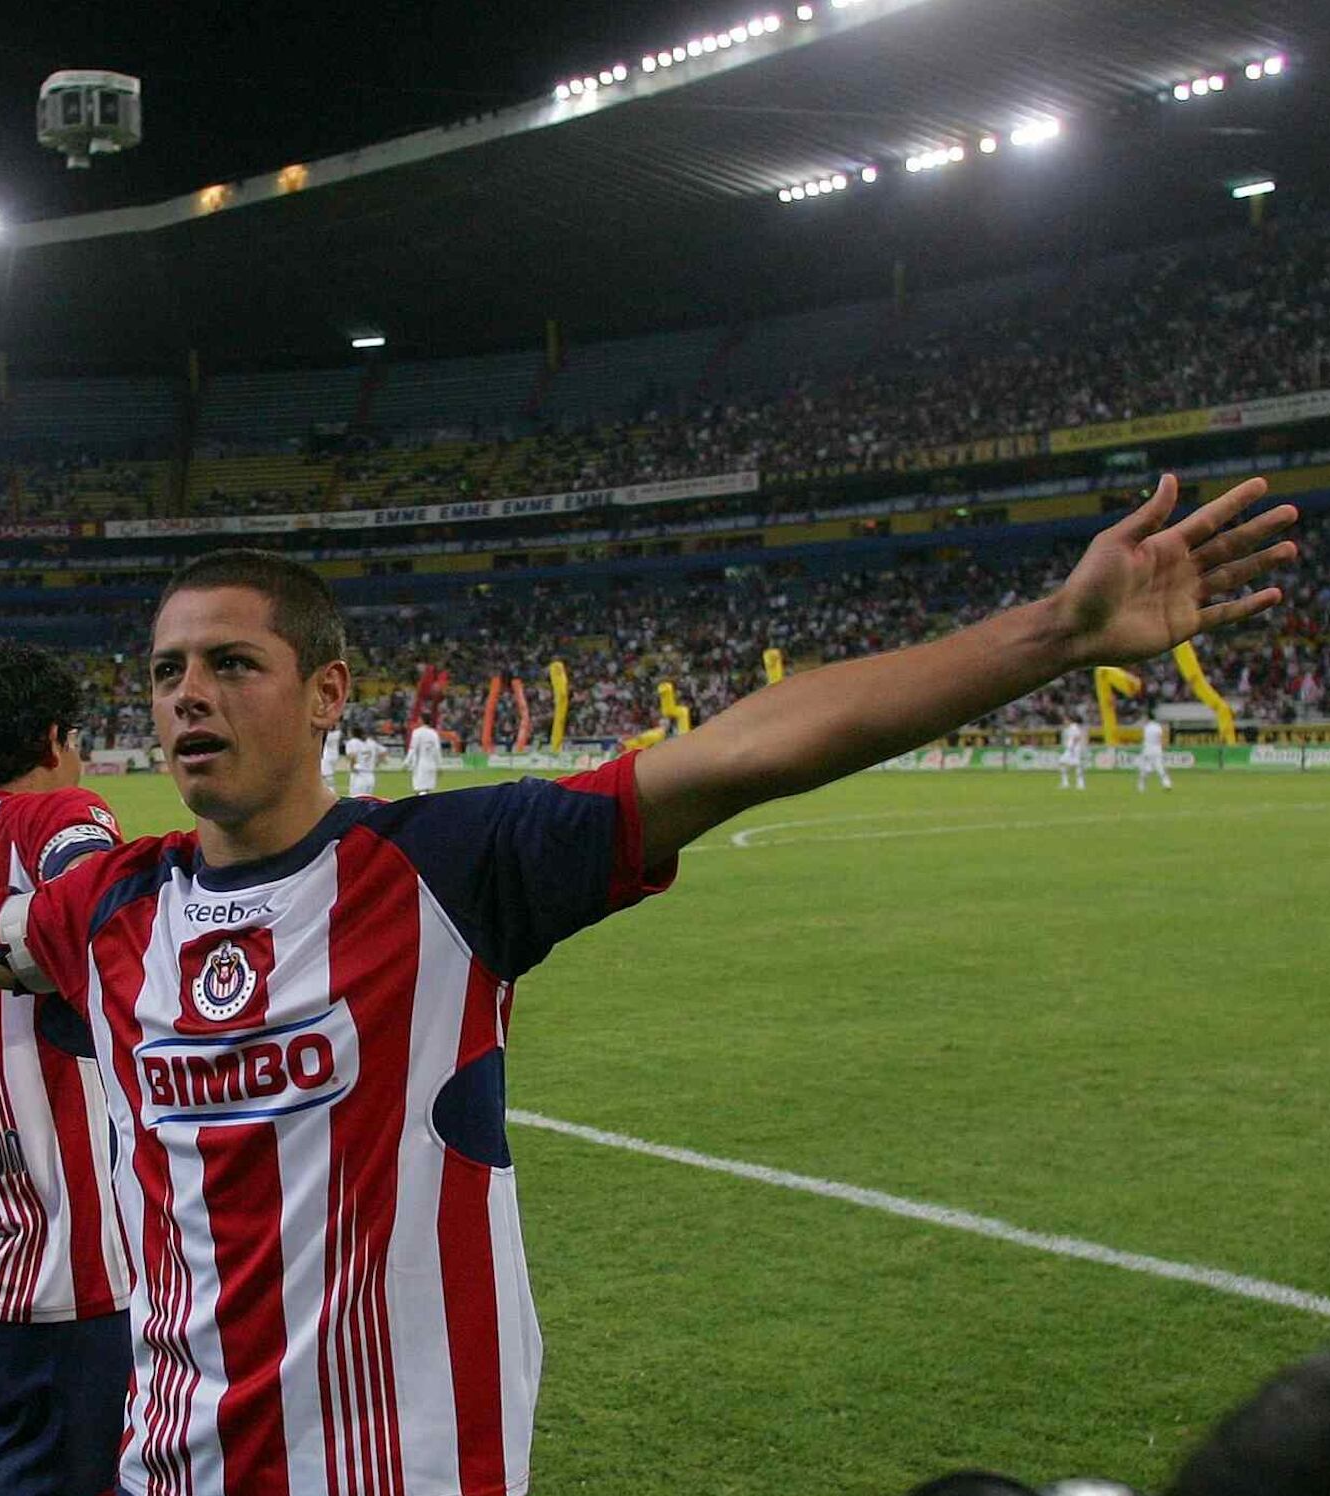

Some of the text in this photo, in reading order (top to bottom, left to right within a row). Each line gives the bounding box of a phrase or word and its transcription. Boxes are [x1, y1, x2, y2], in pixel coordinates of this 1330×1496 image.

[374, 508, 427, 525] EMME
[439, 504, 492, 521] EMME
[142, 1033, 334, 1107] BIMBO
